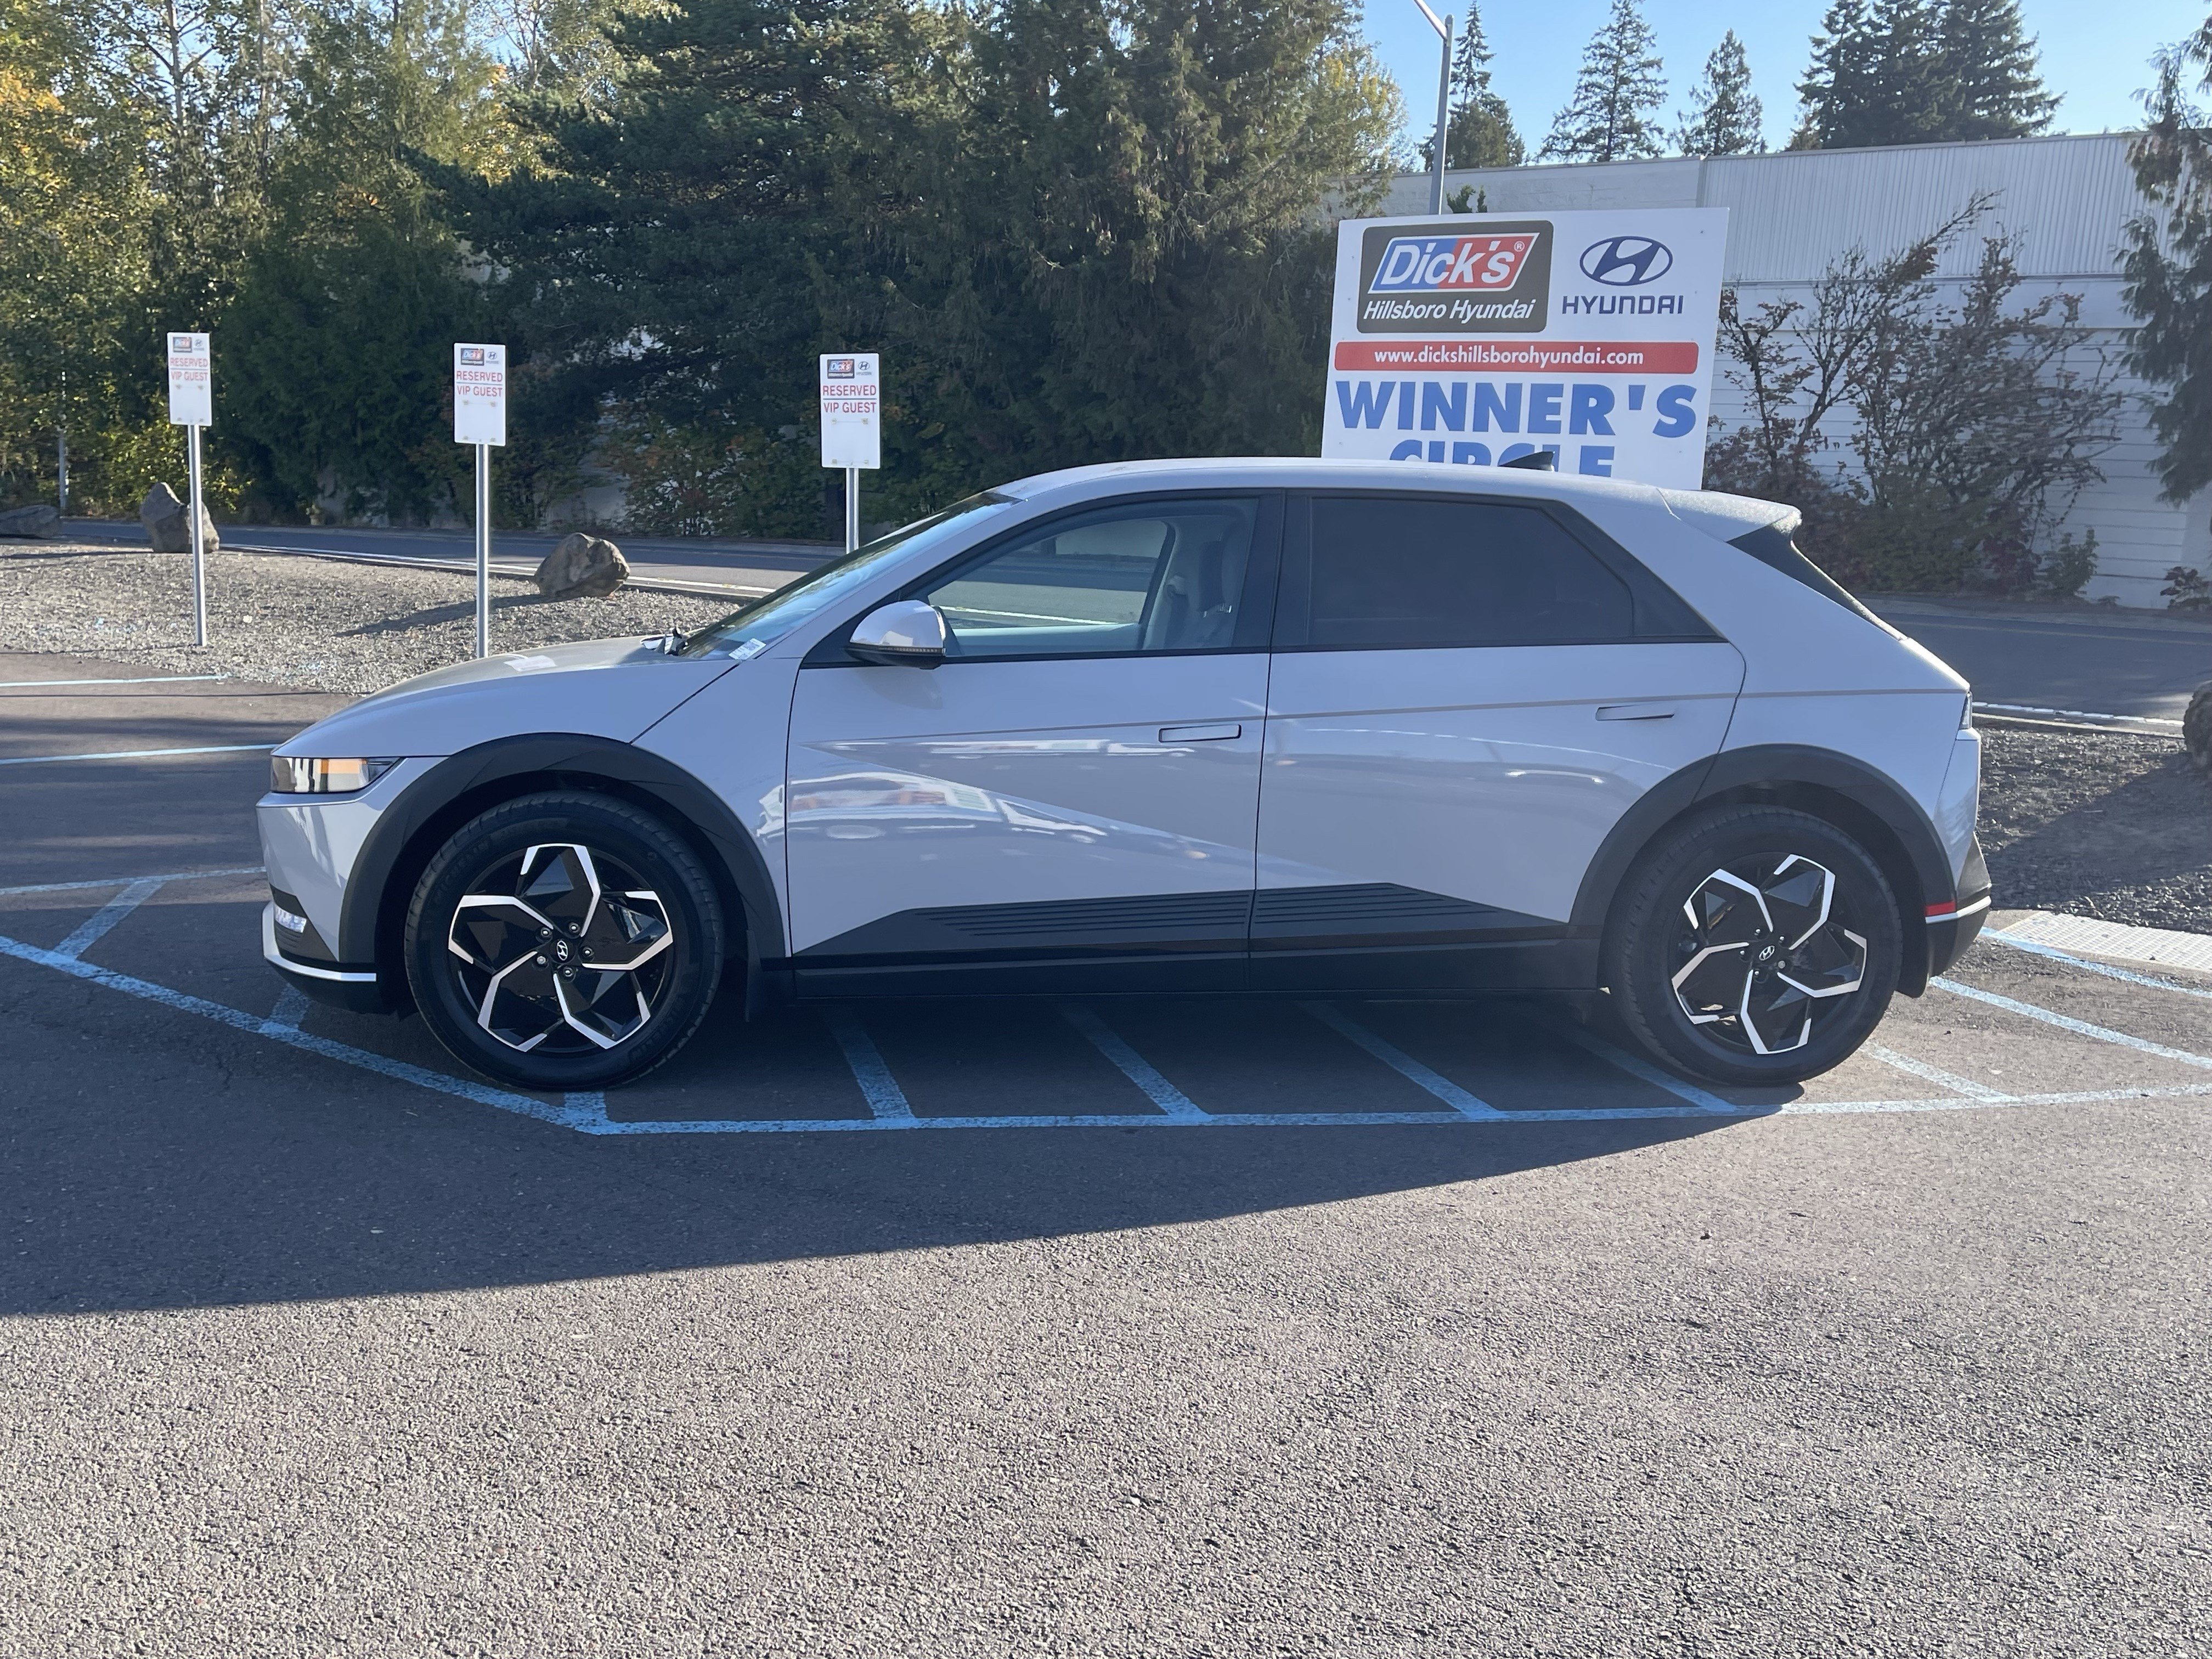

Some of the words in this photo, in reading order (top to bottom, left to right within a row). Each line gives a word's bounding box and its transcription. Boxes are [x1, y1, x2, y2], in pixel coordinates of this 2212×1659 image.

[1381, 240, 1515, 285] Dick's
[1562, 295, 1684, 315] HYUNDAI
[1363, 300, 1448, 320] Hillsboro
[1449, 299, 1536, 324] Hyundai
[170, 357, 208, 368] RESERVED
[1374, 345, 1644, 369] www.dickshillsborohyundai.com
[171, 371, 183, 380] VIP
[184, 371, 208, 381] GUEST
[456, 370, 503, 382] RESERVED
[456, 385, 471, 395] VIP
[473, 386, 503, 397] GUEST
[822, 385, 877, 396] RESERVED
[823, 402, 839, 413] VIP
[842, 402, 877, 413] GUEST
[1335, 380, 1697, 438] WINNER'S
